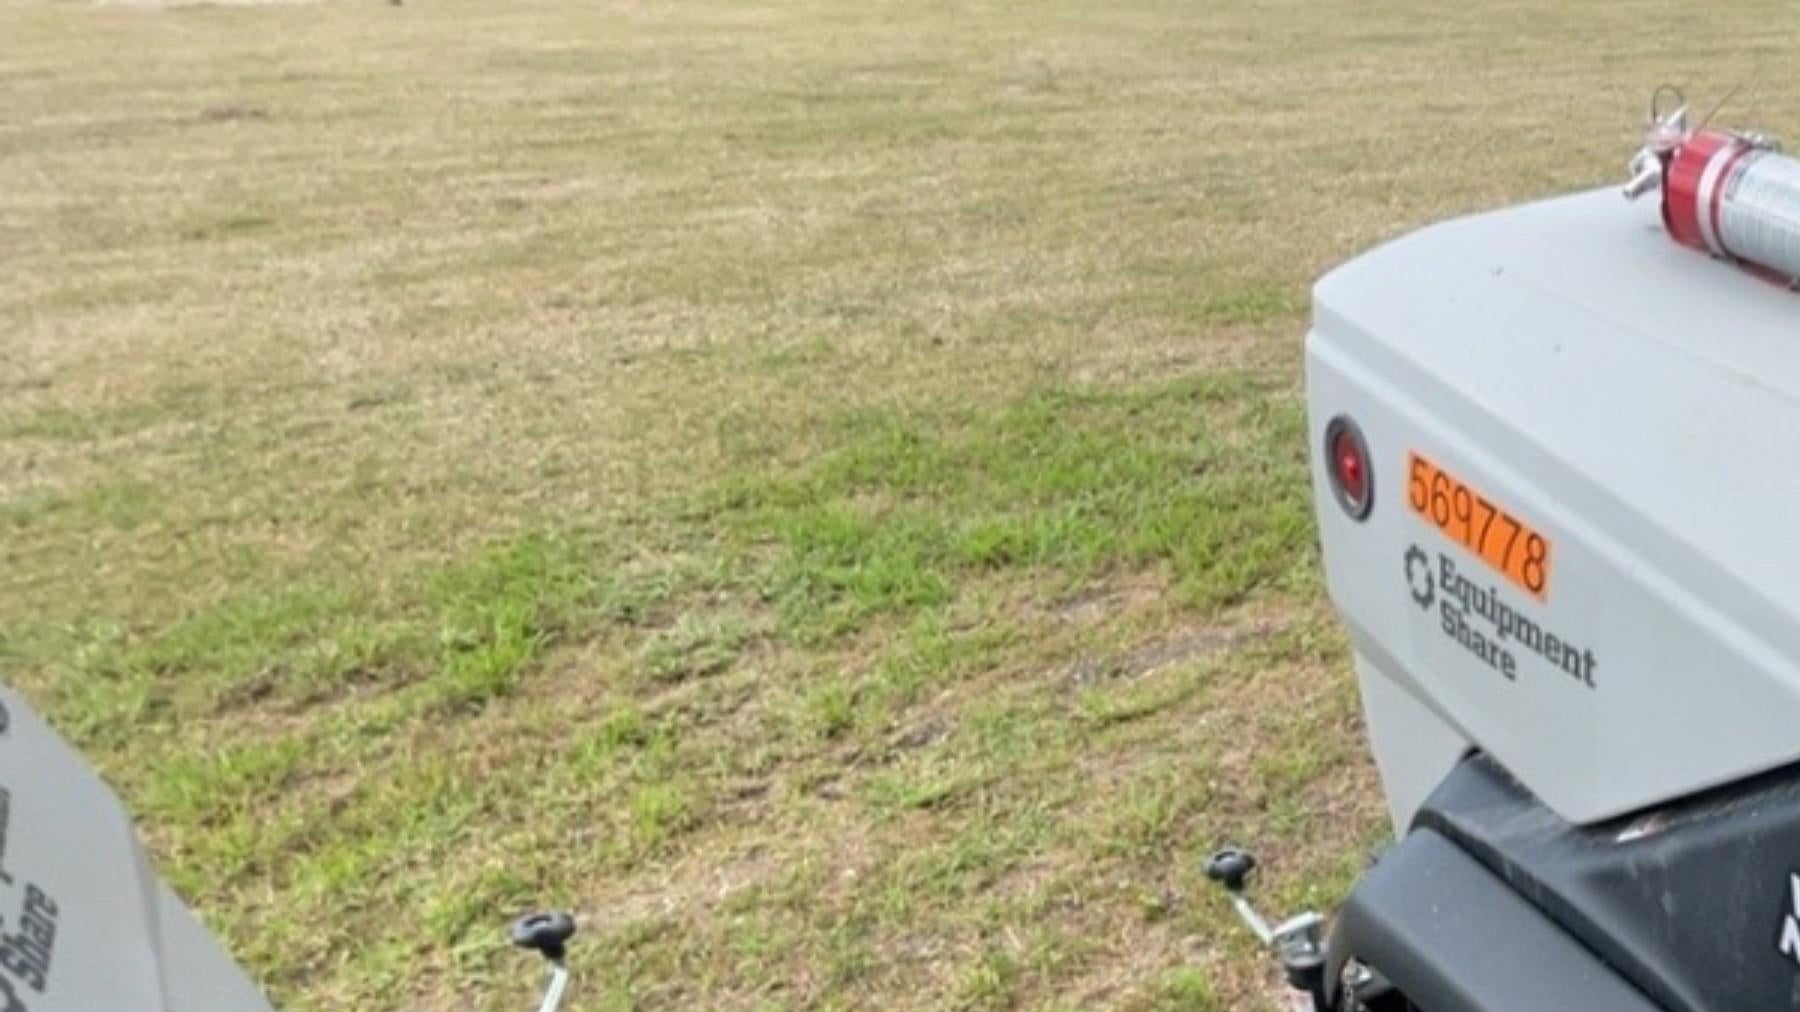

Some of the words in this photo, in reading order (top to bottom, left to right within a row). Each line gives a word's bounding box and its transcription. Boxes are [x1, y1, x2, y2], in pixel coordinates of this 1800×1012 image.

[1409, 455, 1547, 595] 569778
[1438, 553, 1597, 689] Equipment
[1439, 600, 1518, 681] Share
[0, 881, 60, 993] Share
